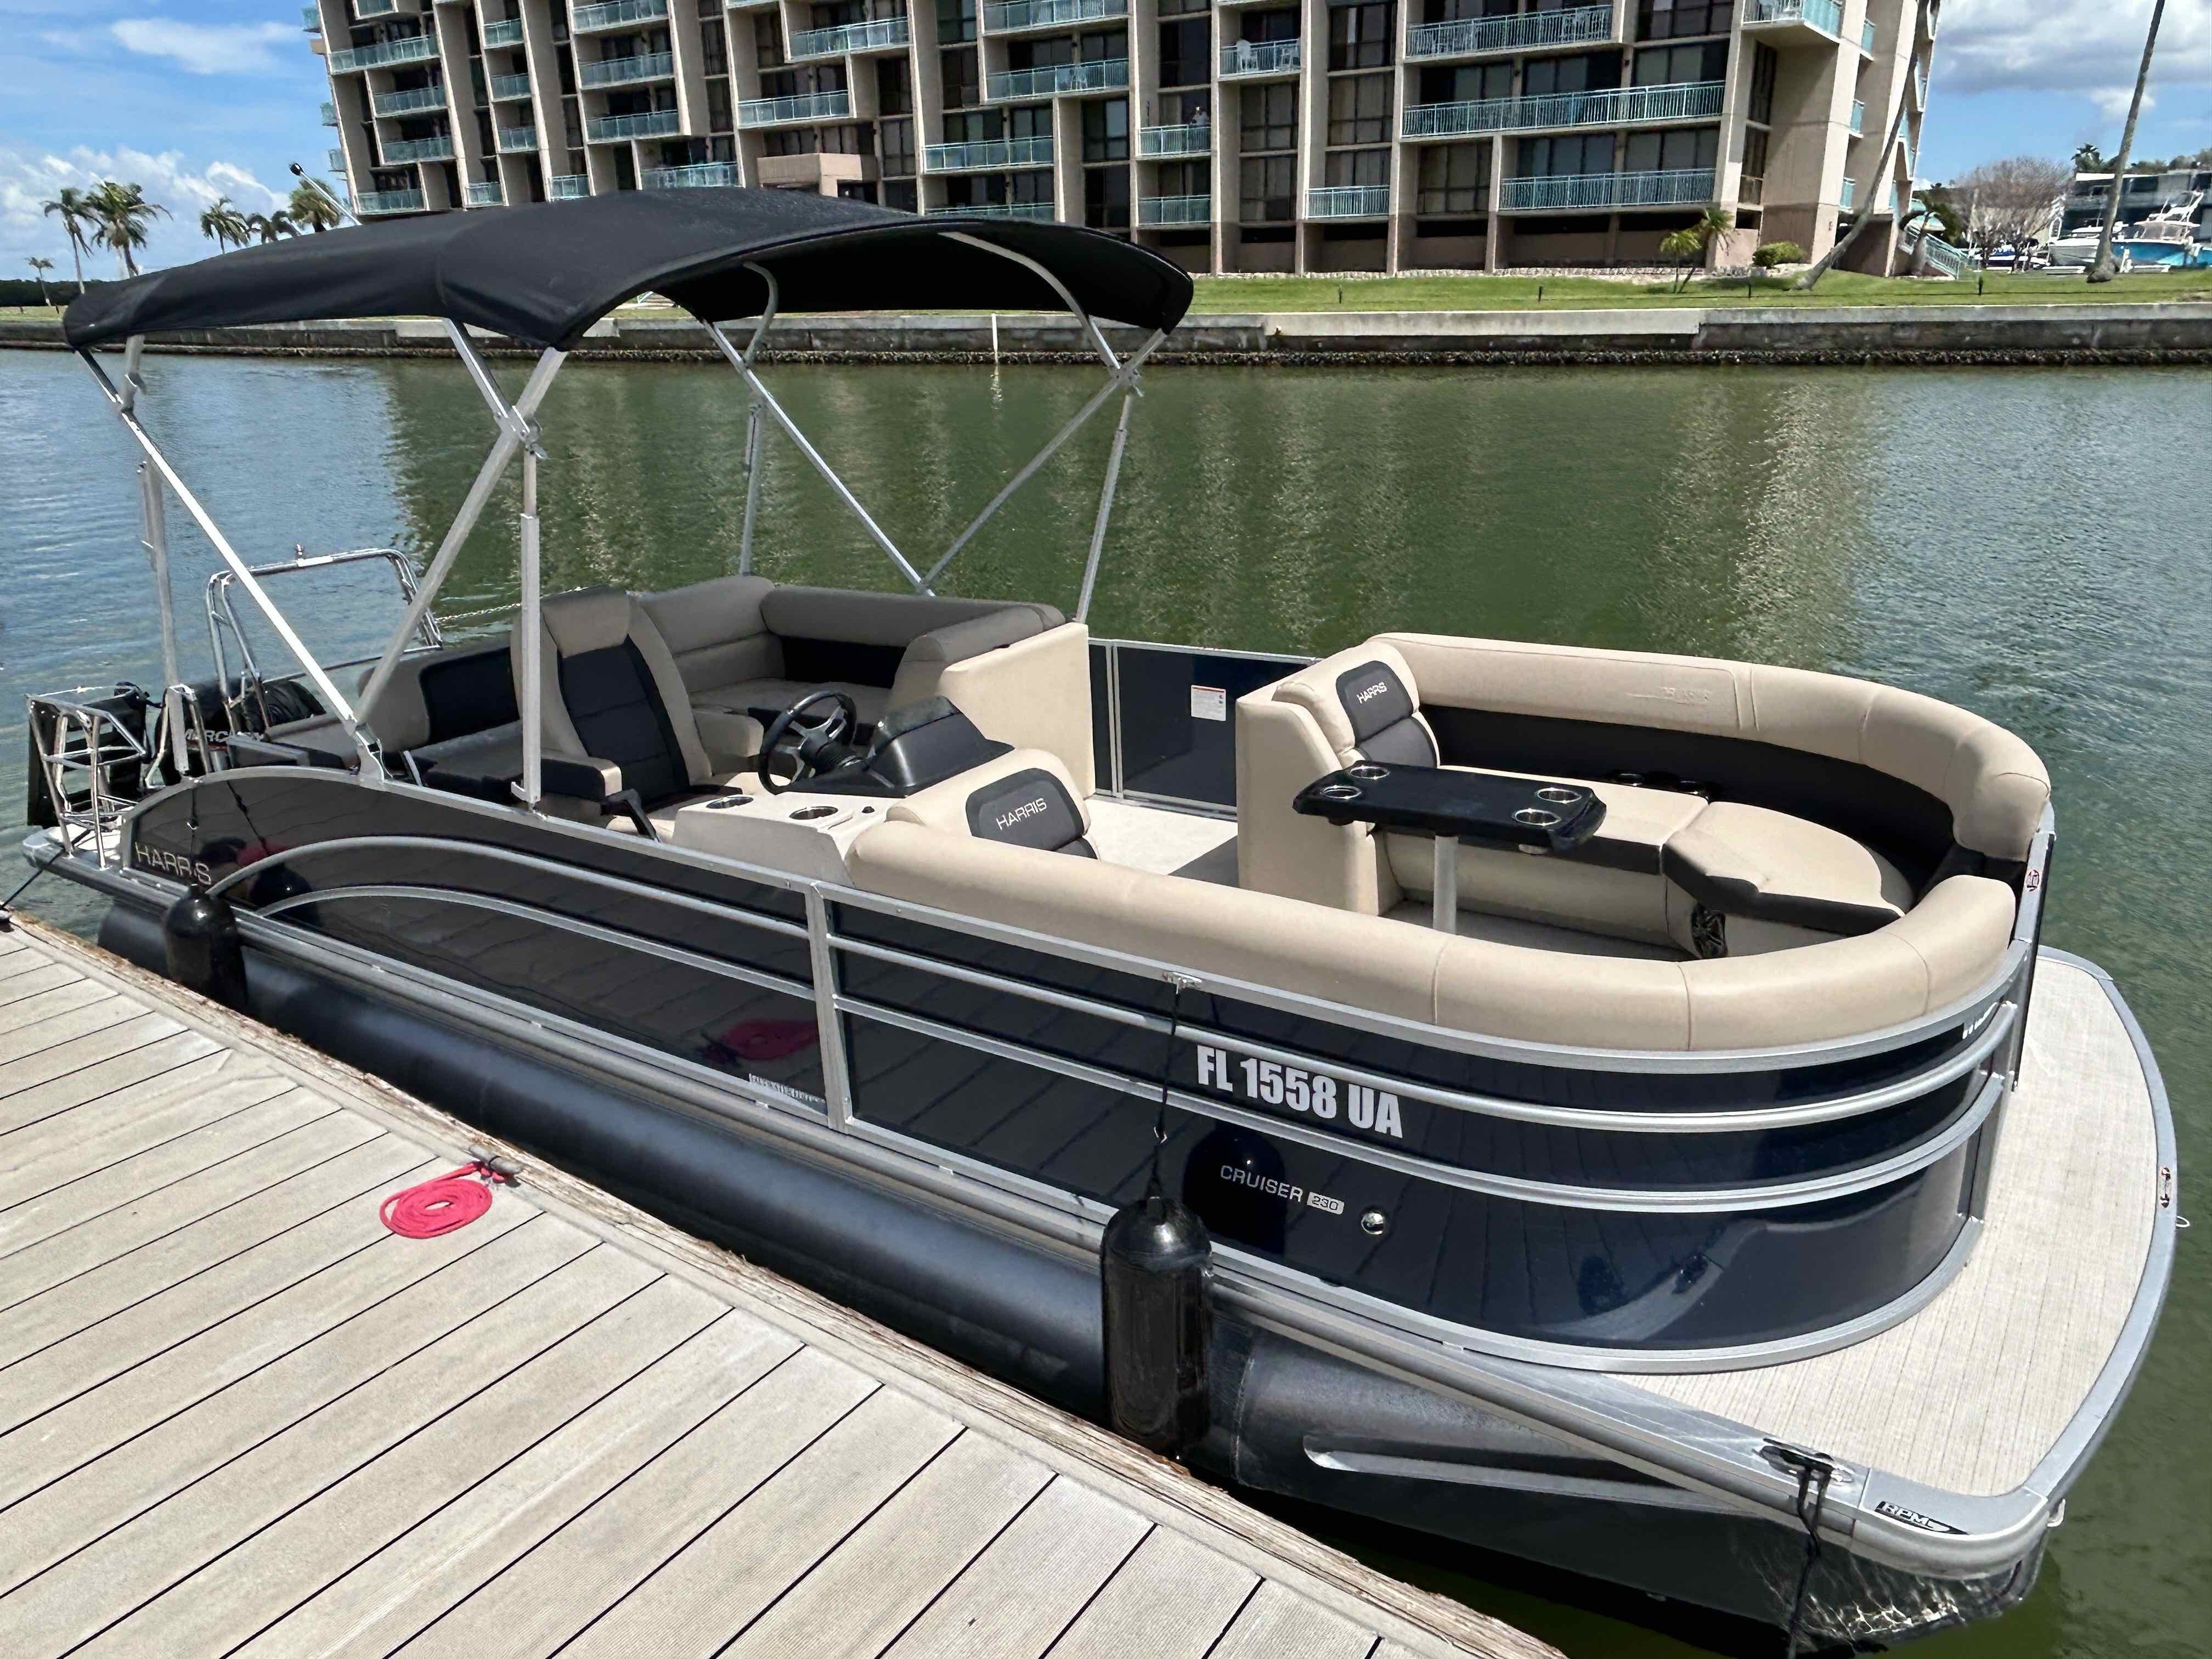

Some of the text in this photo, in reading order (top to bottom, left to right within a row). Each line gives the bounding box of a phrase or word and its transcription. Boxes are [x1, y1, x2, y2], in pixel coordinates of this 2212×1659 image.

[996, 798, 1047, 830] HARRIS
[1197, 1045, 1403, 1138] FL 1558 UA
[1220, 1165, 1339, 1210] CRUISER 230
